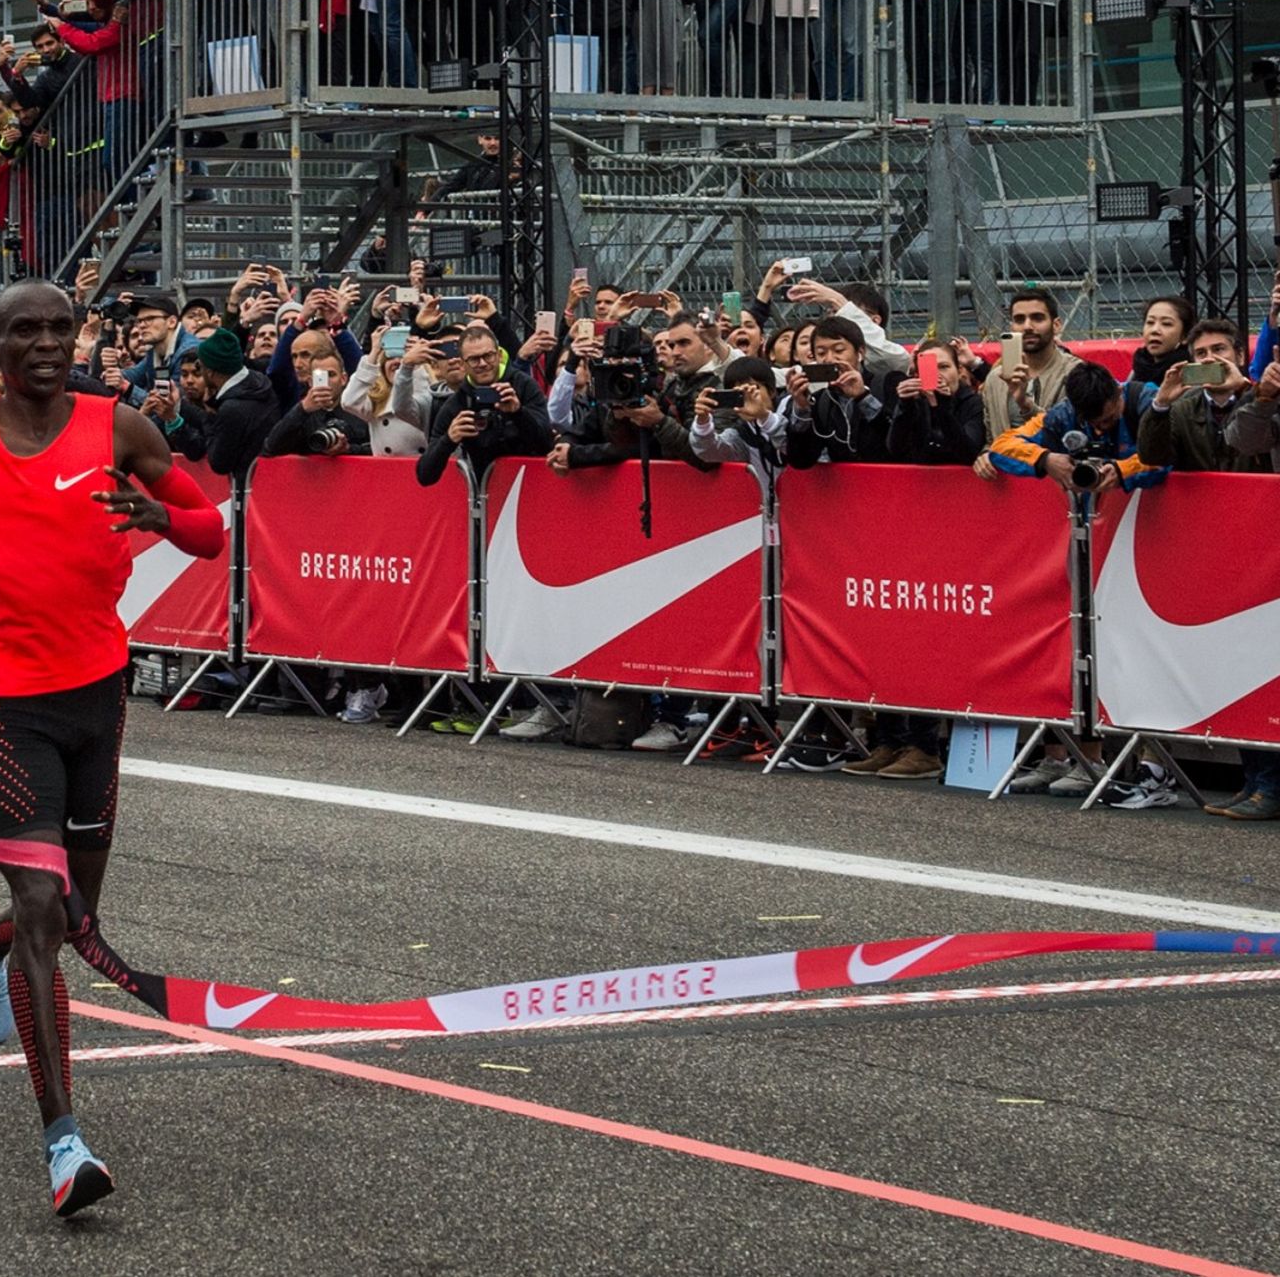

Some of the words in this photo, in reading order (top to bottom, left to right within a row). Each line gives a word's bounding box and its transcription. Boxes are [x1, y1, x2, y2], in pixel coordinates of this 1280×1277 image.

[300, 552, 412, 584] BREAKING2
[846, 577, 993, 616] BREAKING2
[503, 966, 717, 1021] BREAKING2
